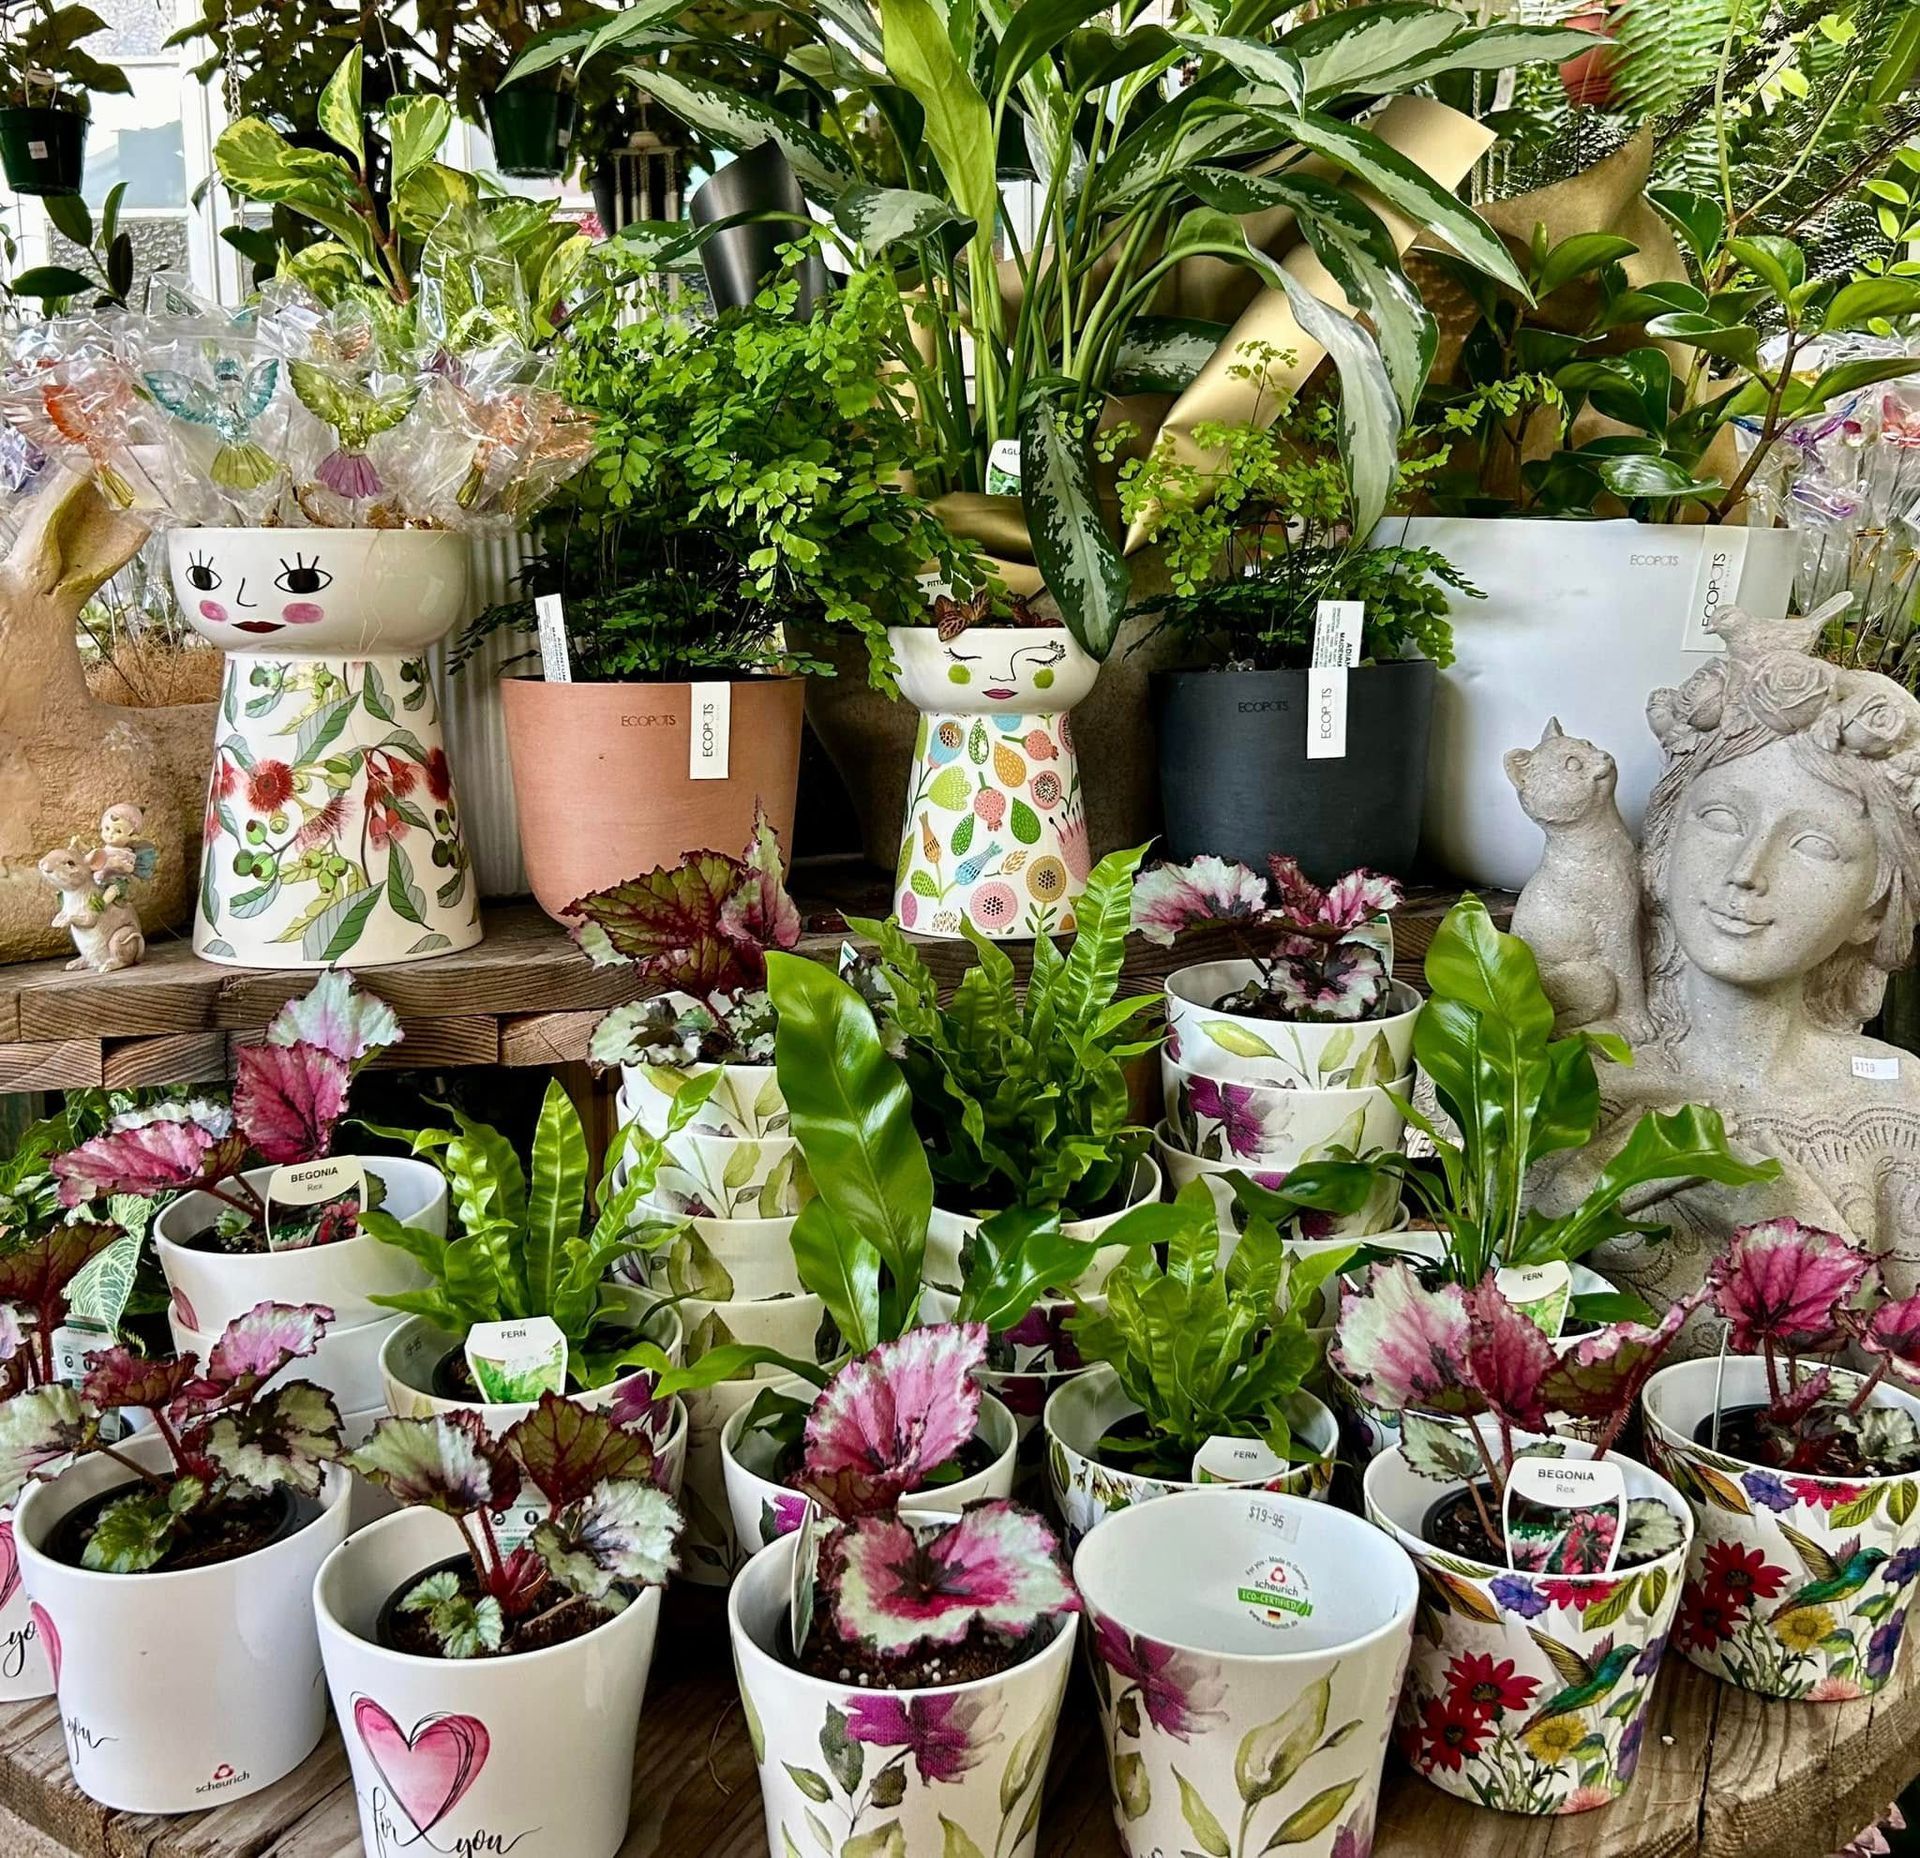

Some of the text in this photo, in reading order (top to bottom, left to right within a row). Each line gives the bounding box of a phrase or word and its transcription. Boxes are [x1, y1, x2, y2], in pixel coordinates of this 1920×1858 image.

[1629, 554, 1679, 567] ECOPOTS
[1701, 553, 1726, 628] ECOPOTS
[1238, 701, 1289, 713] ECOPOTS
[1321, 688, 1332, 739] ECOPOTS
[621, 715, 676, 727] ECOPOTS
[702, 703, 714, 757] ECOPOTS
[290, 1166, 339, 1183] BEGONIA
[306, 1183, 323, 1192] Rex
[1522, 1271, 1543, 1281] FERN
[501, 1329, 527, 1339] FERN
[1233, 1449, 1258, 1459] FERN
[1538, 1468, 1595, 1481] BEGONIA
[1556, 1484, 1575, 1494] Rex
[1248, 1505, 1285, 1530] $19-95
[1254, 1579, 1299, 1598] scheurich
[1241, 1590, 1297, 1610] ECO-CERTIFIED
[0, 1620, 38, 1678] yo
[195, 1770, 250, 1793] scheurich
